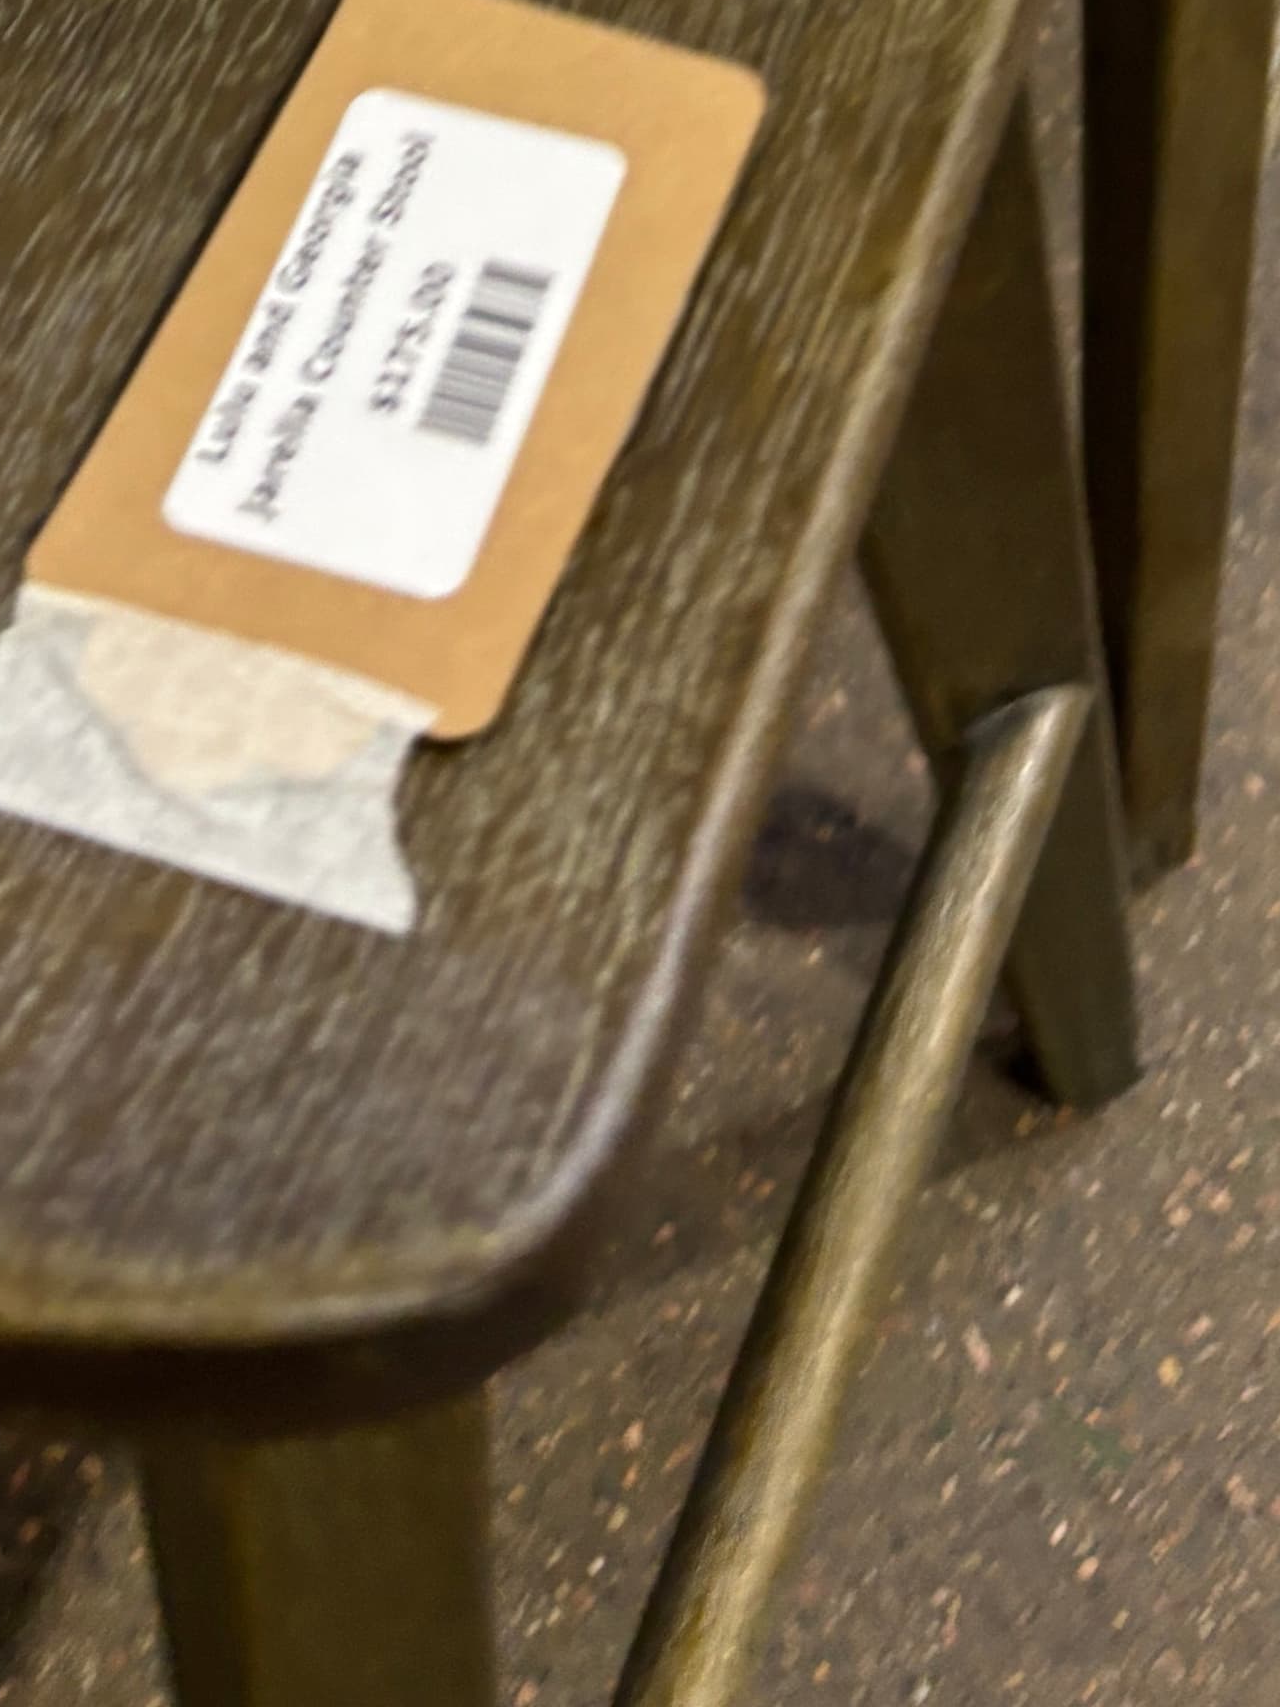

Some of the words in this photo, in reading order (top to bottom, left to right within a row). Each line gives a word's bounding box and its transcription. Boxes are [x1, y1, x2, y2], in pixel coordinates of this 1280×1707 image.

[246, 302, 294, 372] and
[279, 150, 362, 292] Georgia
[302, 235, 385, 383] Counter
[370, 132, 433, 226] Stool
